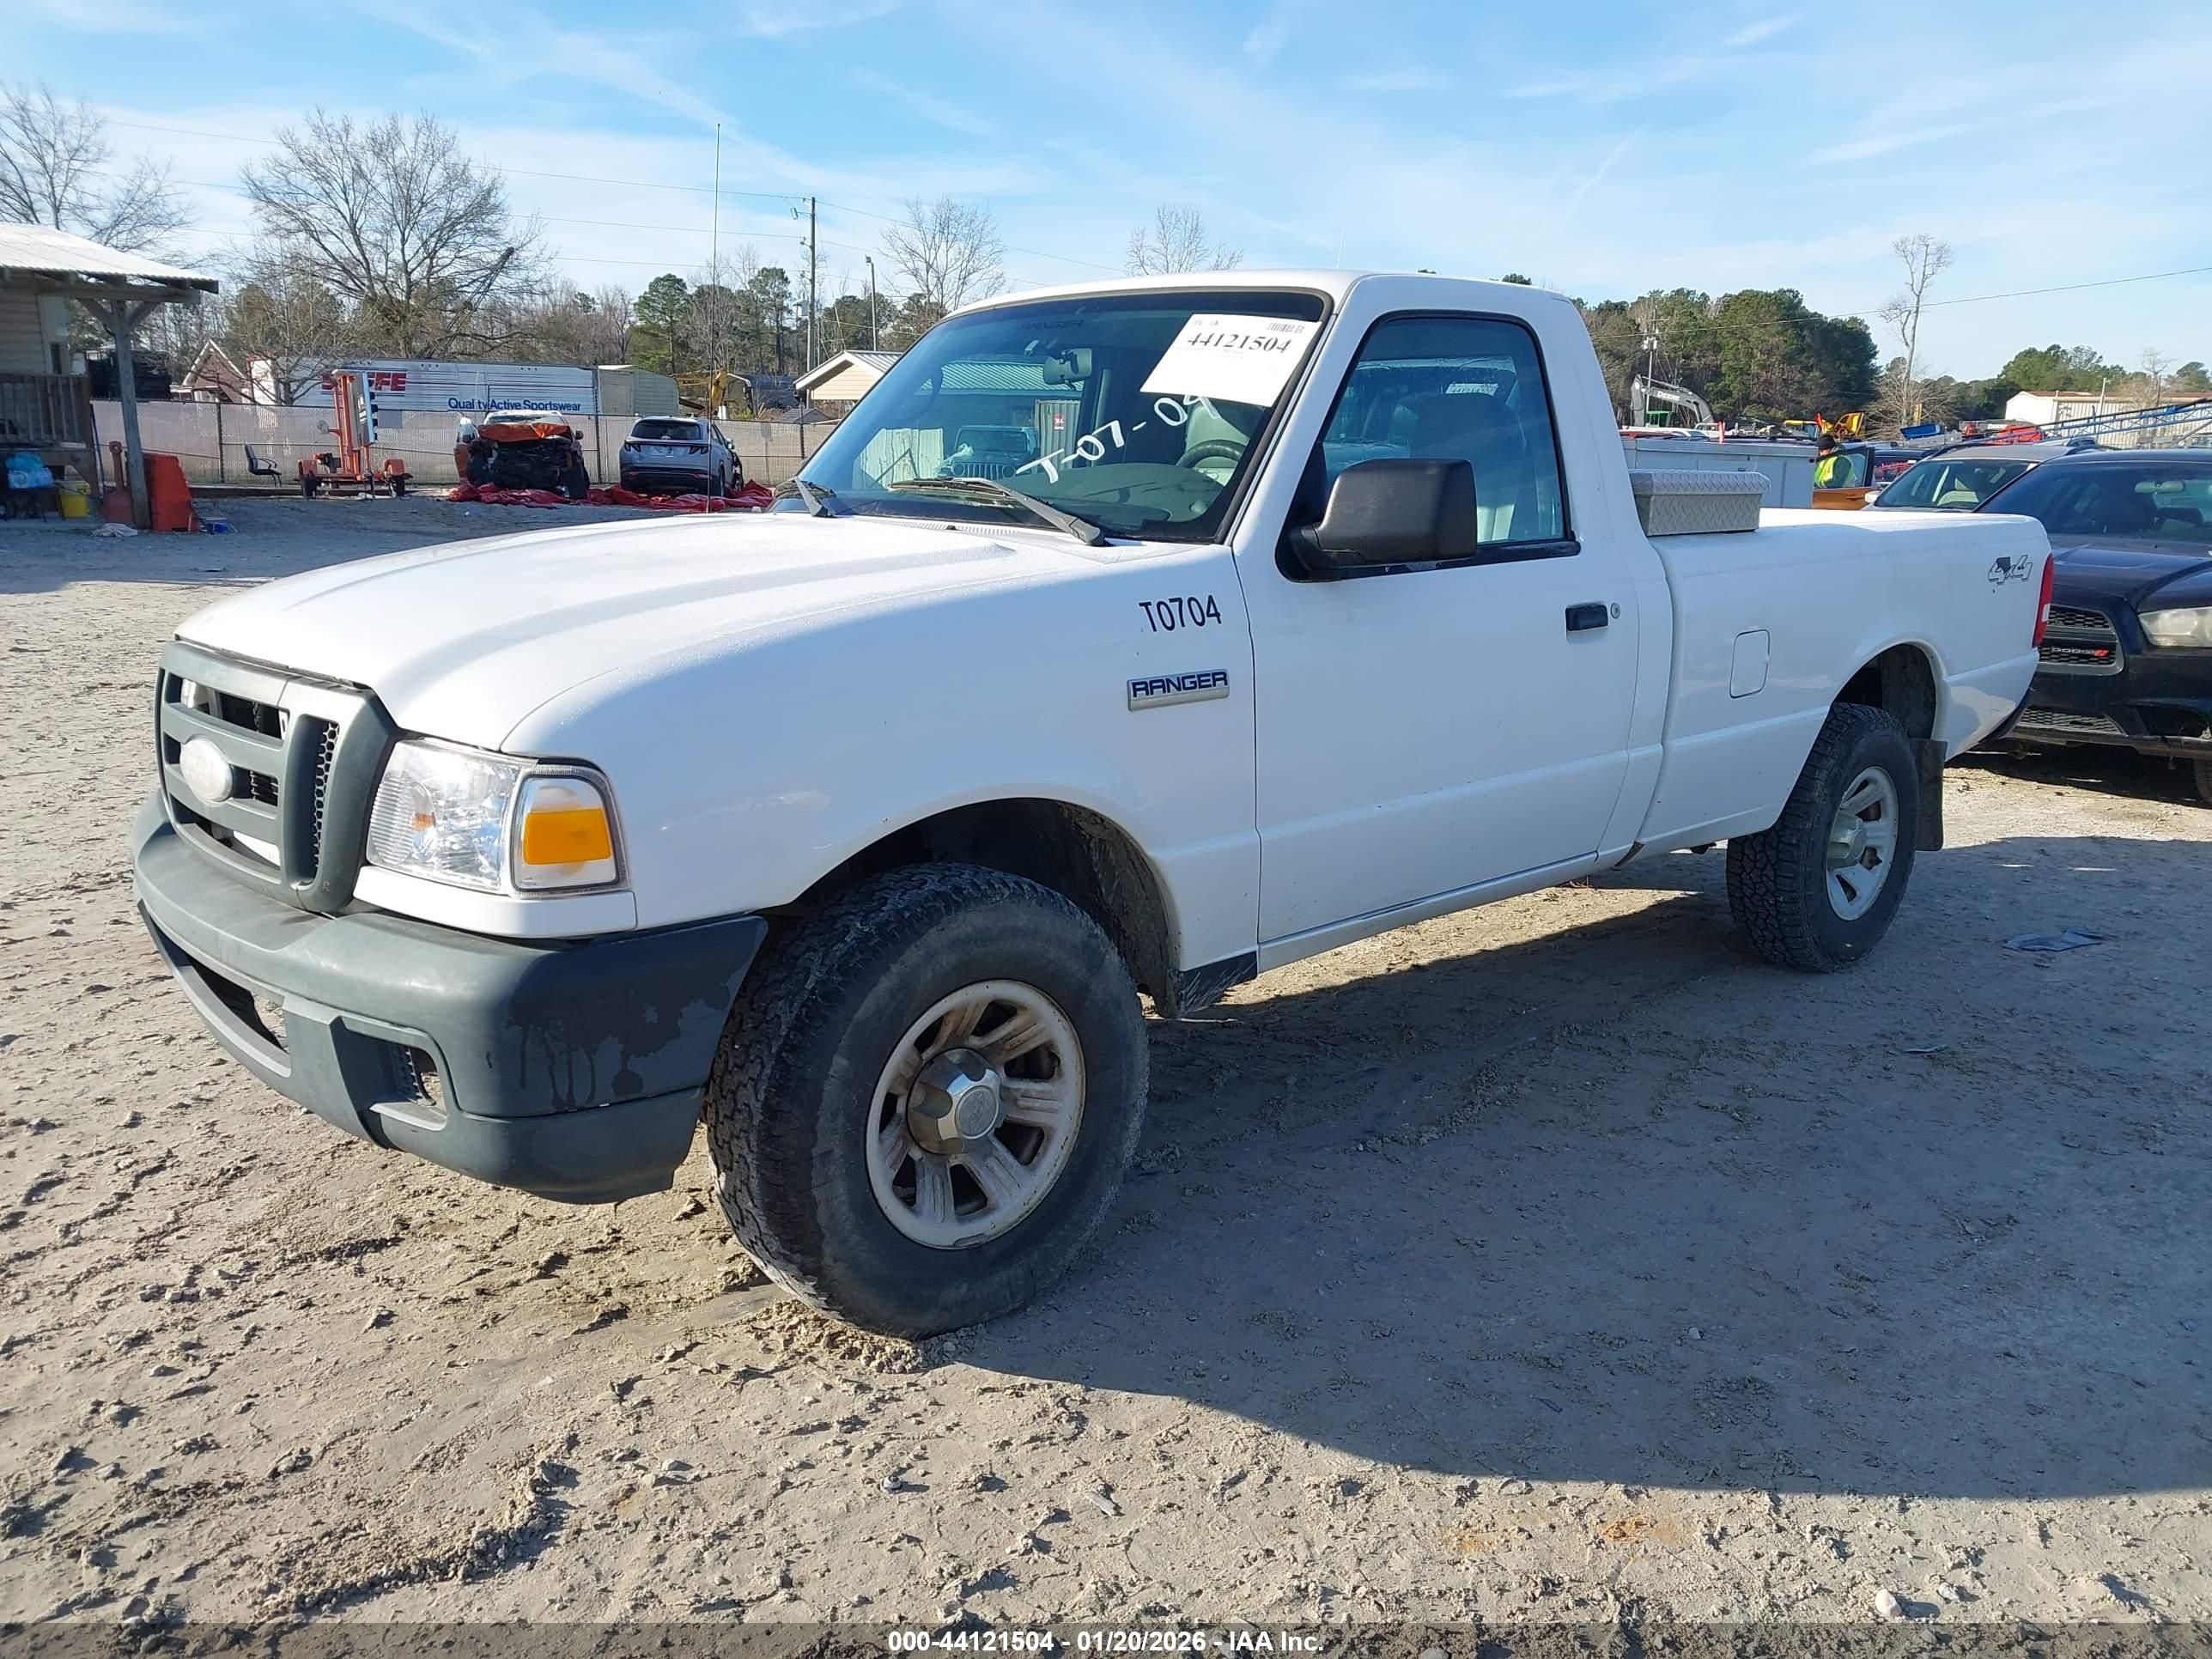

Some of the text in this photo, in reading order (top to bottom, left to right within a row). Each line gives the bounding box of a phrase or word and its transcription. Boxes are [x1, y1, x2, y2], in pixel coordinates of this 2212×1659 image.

[1188, 332, 1292, 354] 44121504
[447, 397, 581, 412] Qualty Active Sportswear
[1138, 594, 1222, 633] T0704
[1132, 672, 1229, 697] RANGER
